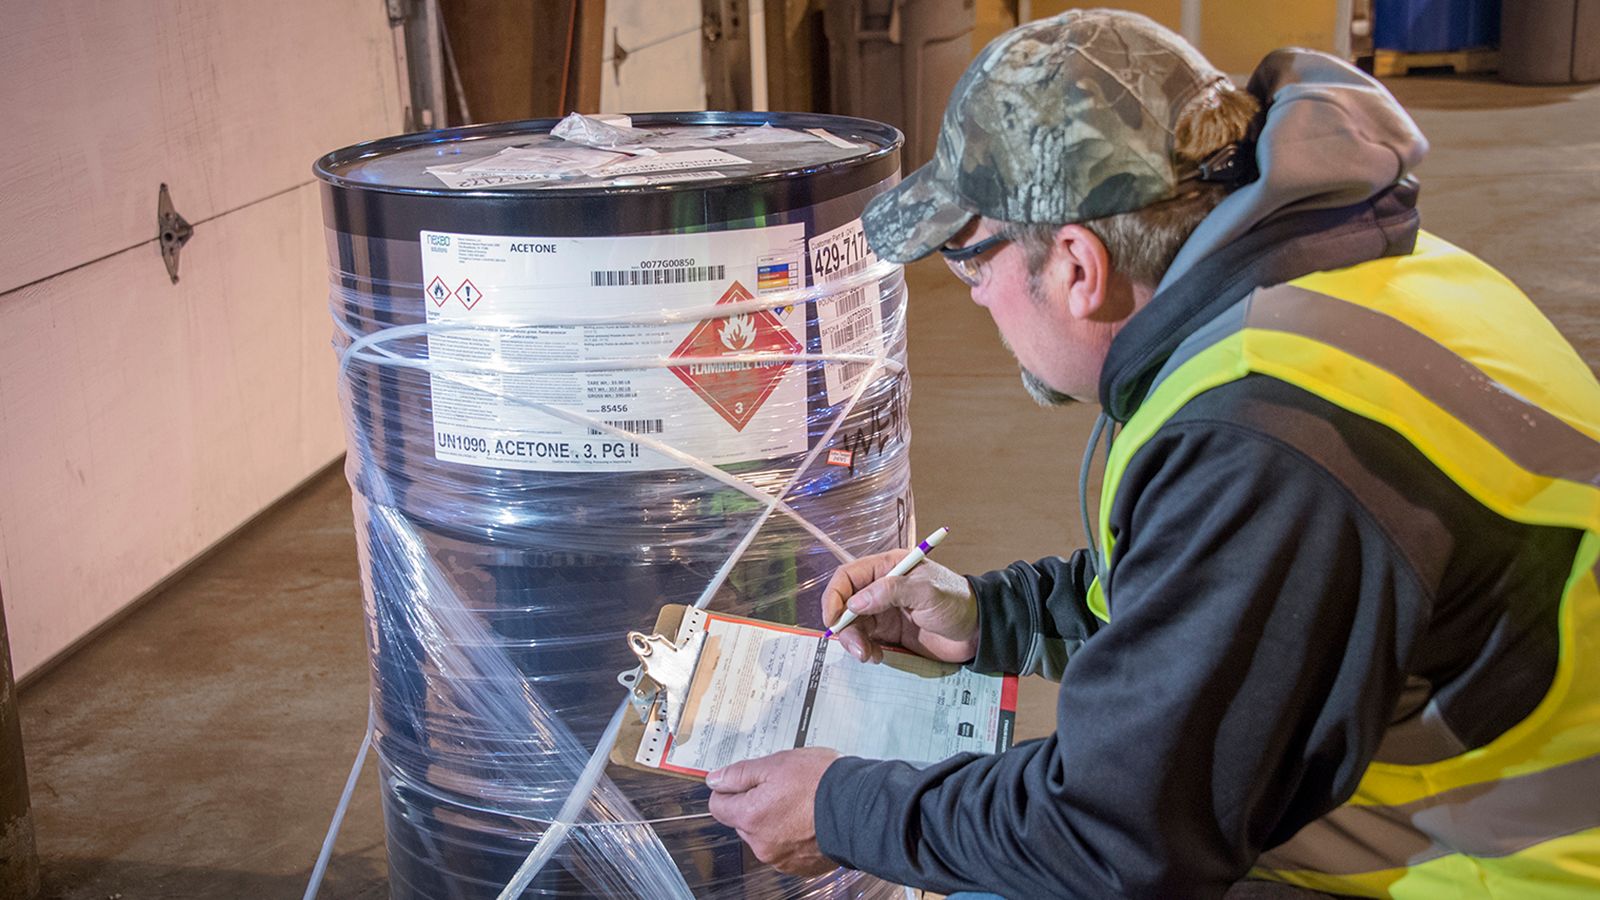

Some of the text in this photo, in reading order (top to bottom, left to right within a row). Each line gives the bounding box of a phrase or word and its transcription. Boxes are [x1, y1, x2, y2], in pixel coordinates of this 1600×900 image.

[510, 243, 557, 253] ACETONE
[640, 258, 695, 269] 0077G00850
[689, 358, 753, 376] FLAMMABLE
[600, 404, 628, 413] 85456
[734, 402, 744, 414] 3
[437, 432, 491, 456] UN1090,
[495, 440, 570, 458] ACETONE
[602, 442, 626, 458] PG
[630, 442, 639, 458] II
